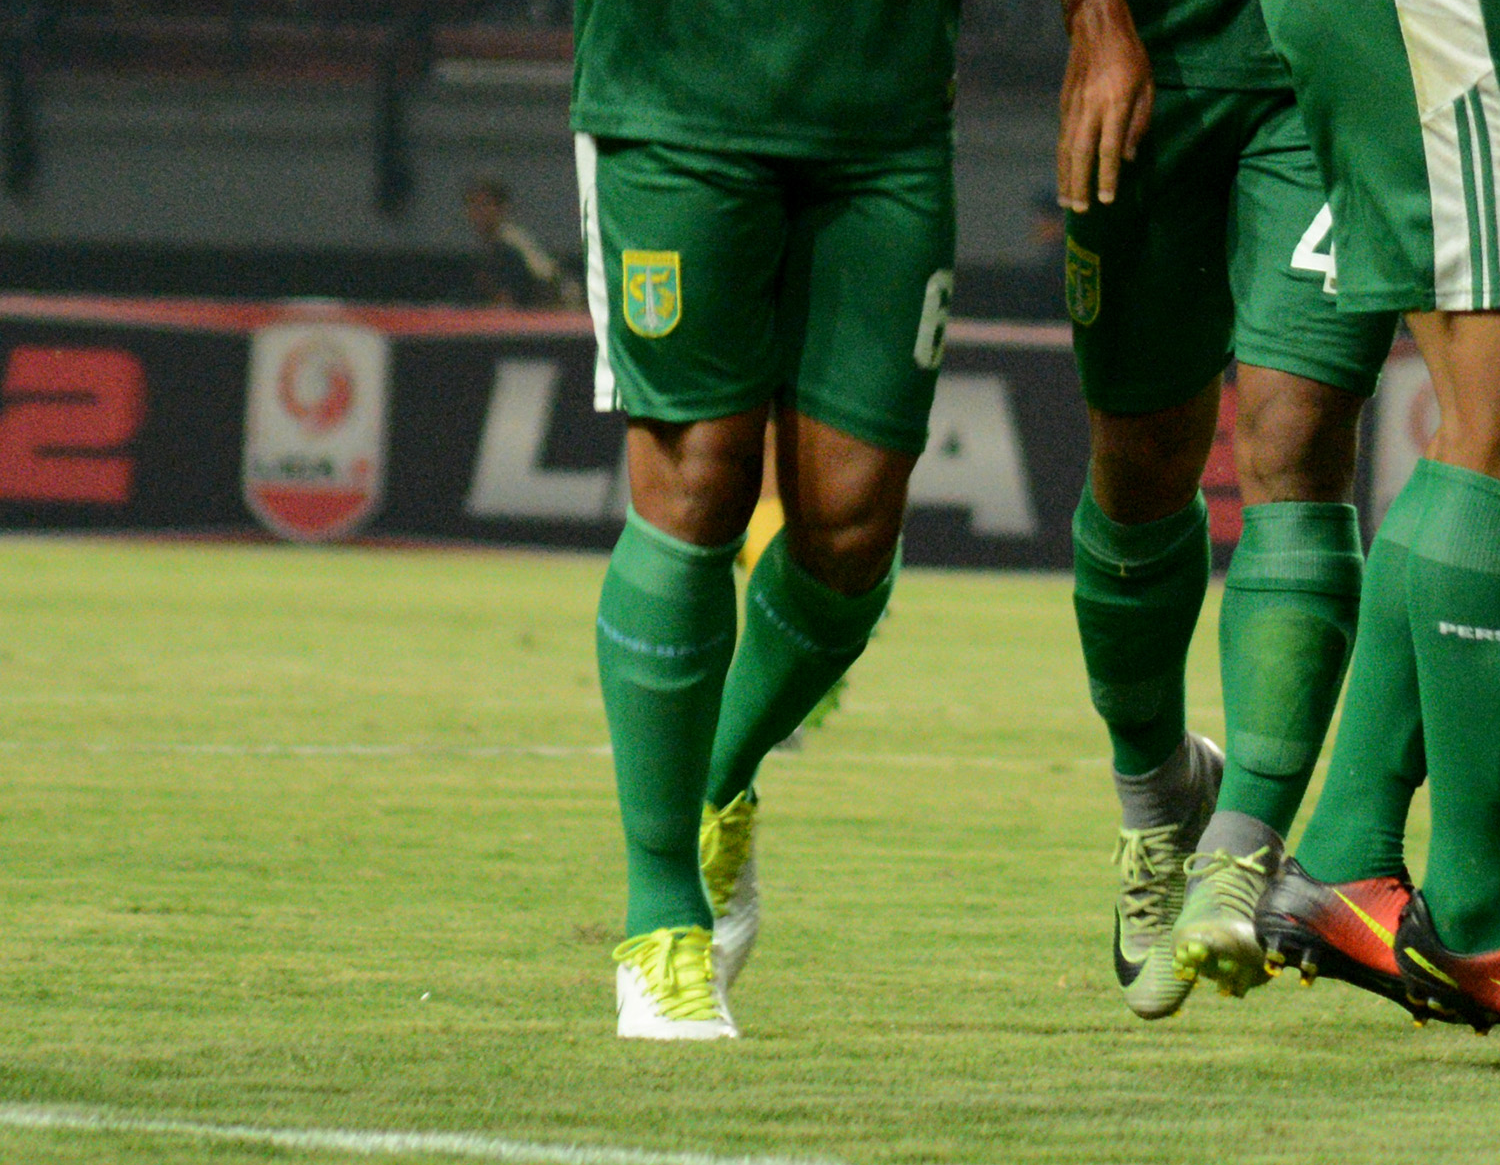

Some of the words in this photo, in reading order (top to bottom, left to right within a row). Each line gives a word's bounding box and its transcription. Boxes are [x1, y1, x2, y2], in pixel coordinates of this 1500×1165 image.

[1290, 202, 1337, 295] 4
[914, 268, 953, 369] 6
[0, 343, 146, 503] 2
